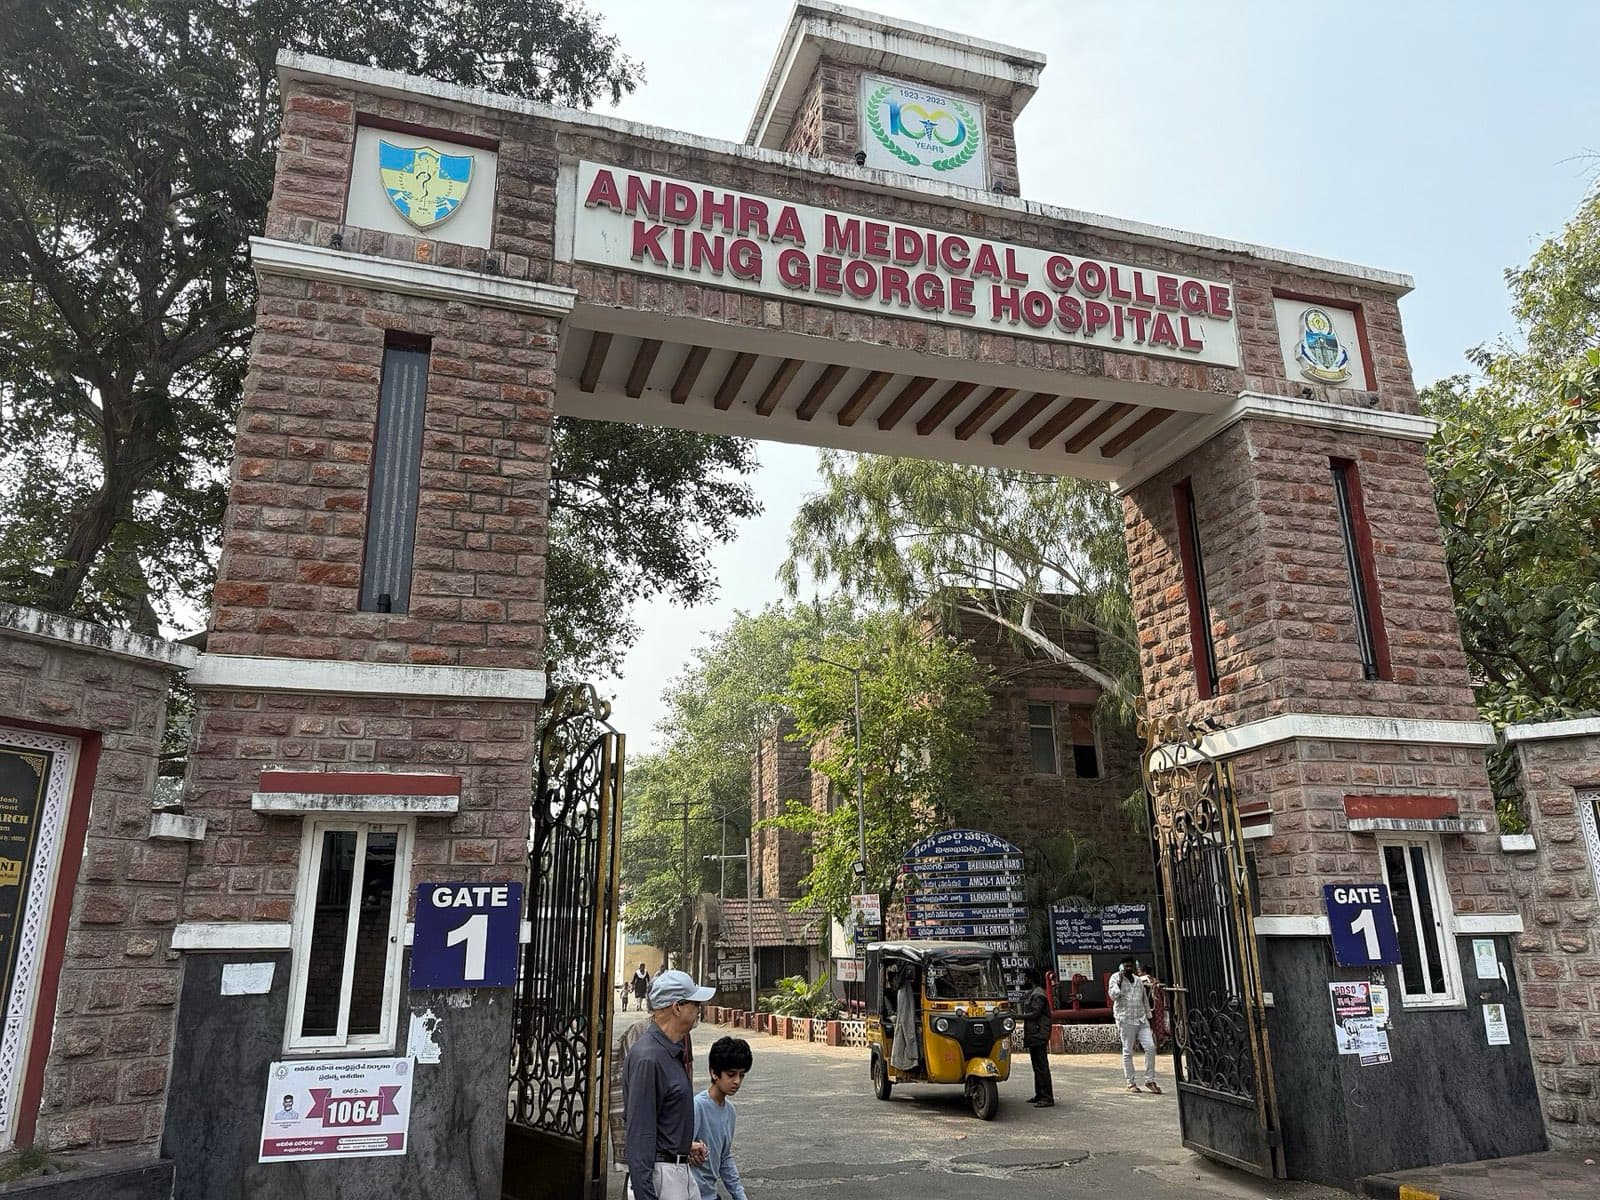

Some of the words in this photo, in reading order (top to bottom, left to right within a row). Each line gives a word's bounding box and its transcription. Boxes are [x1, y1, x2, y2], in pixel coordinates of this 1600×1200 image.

[900, 89, 919, 100] 1923
[926, 95, 946, 105] 2023
[915, 141, 944, 153] YEARS
[584, 168, 806, 248] ANDHRA
[823, 213, 1029, 287] MEDICAL
[1044, 254, 1233, 321] COLLEGE
[630, 219, 763, 283] KING
[778, 248, 976, 317] GEORGE
[990, 284, 1204, 353] HOSPITAL
[432, 886, 509, 908] GATE
[1334, 887, 1382, 904] GATE
[973, 925, 989, 936] MALE
[1350, 908, 1382, 960] 1
[446, 914, 489, 980] 1
[327, 1100, 380, 1124] 1064
